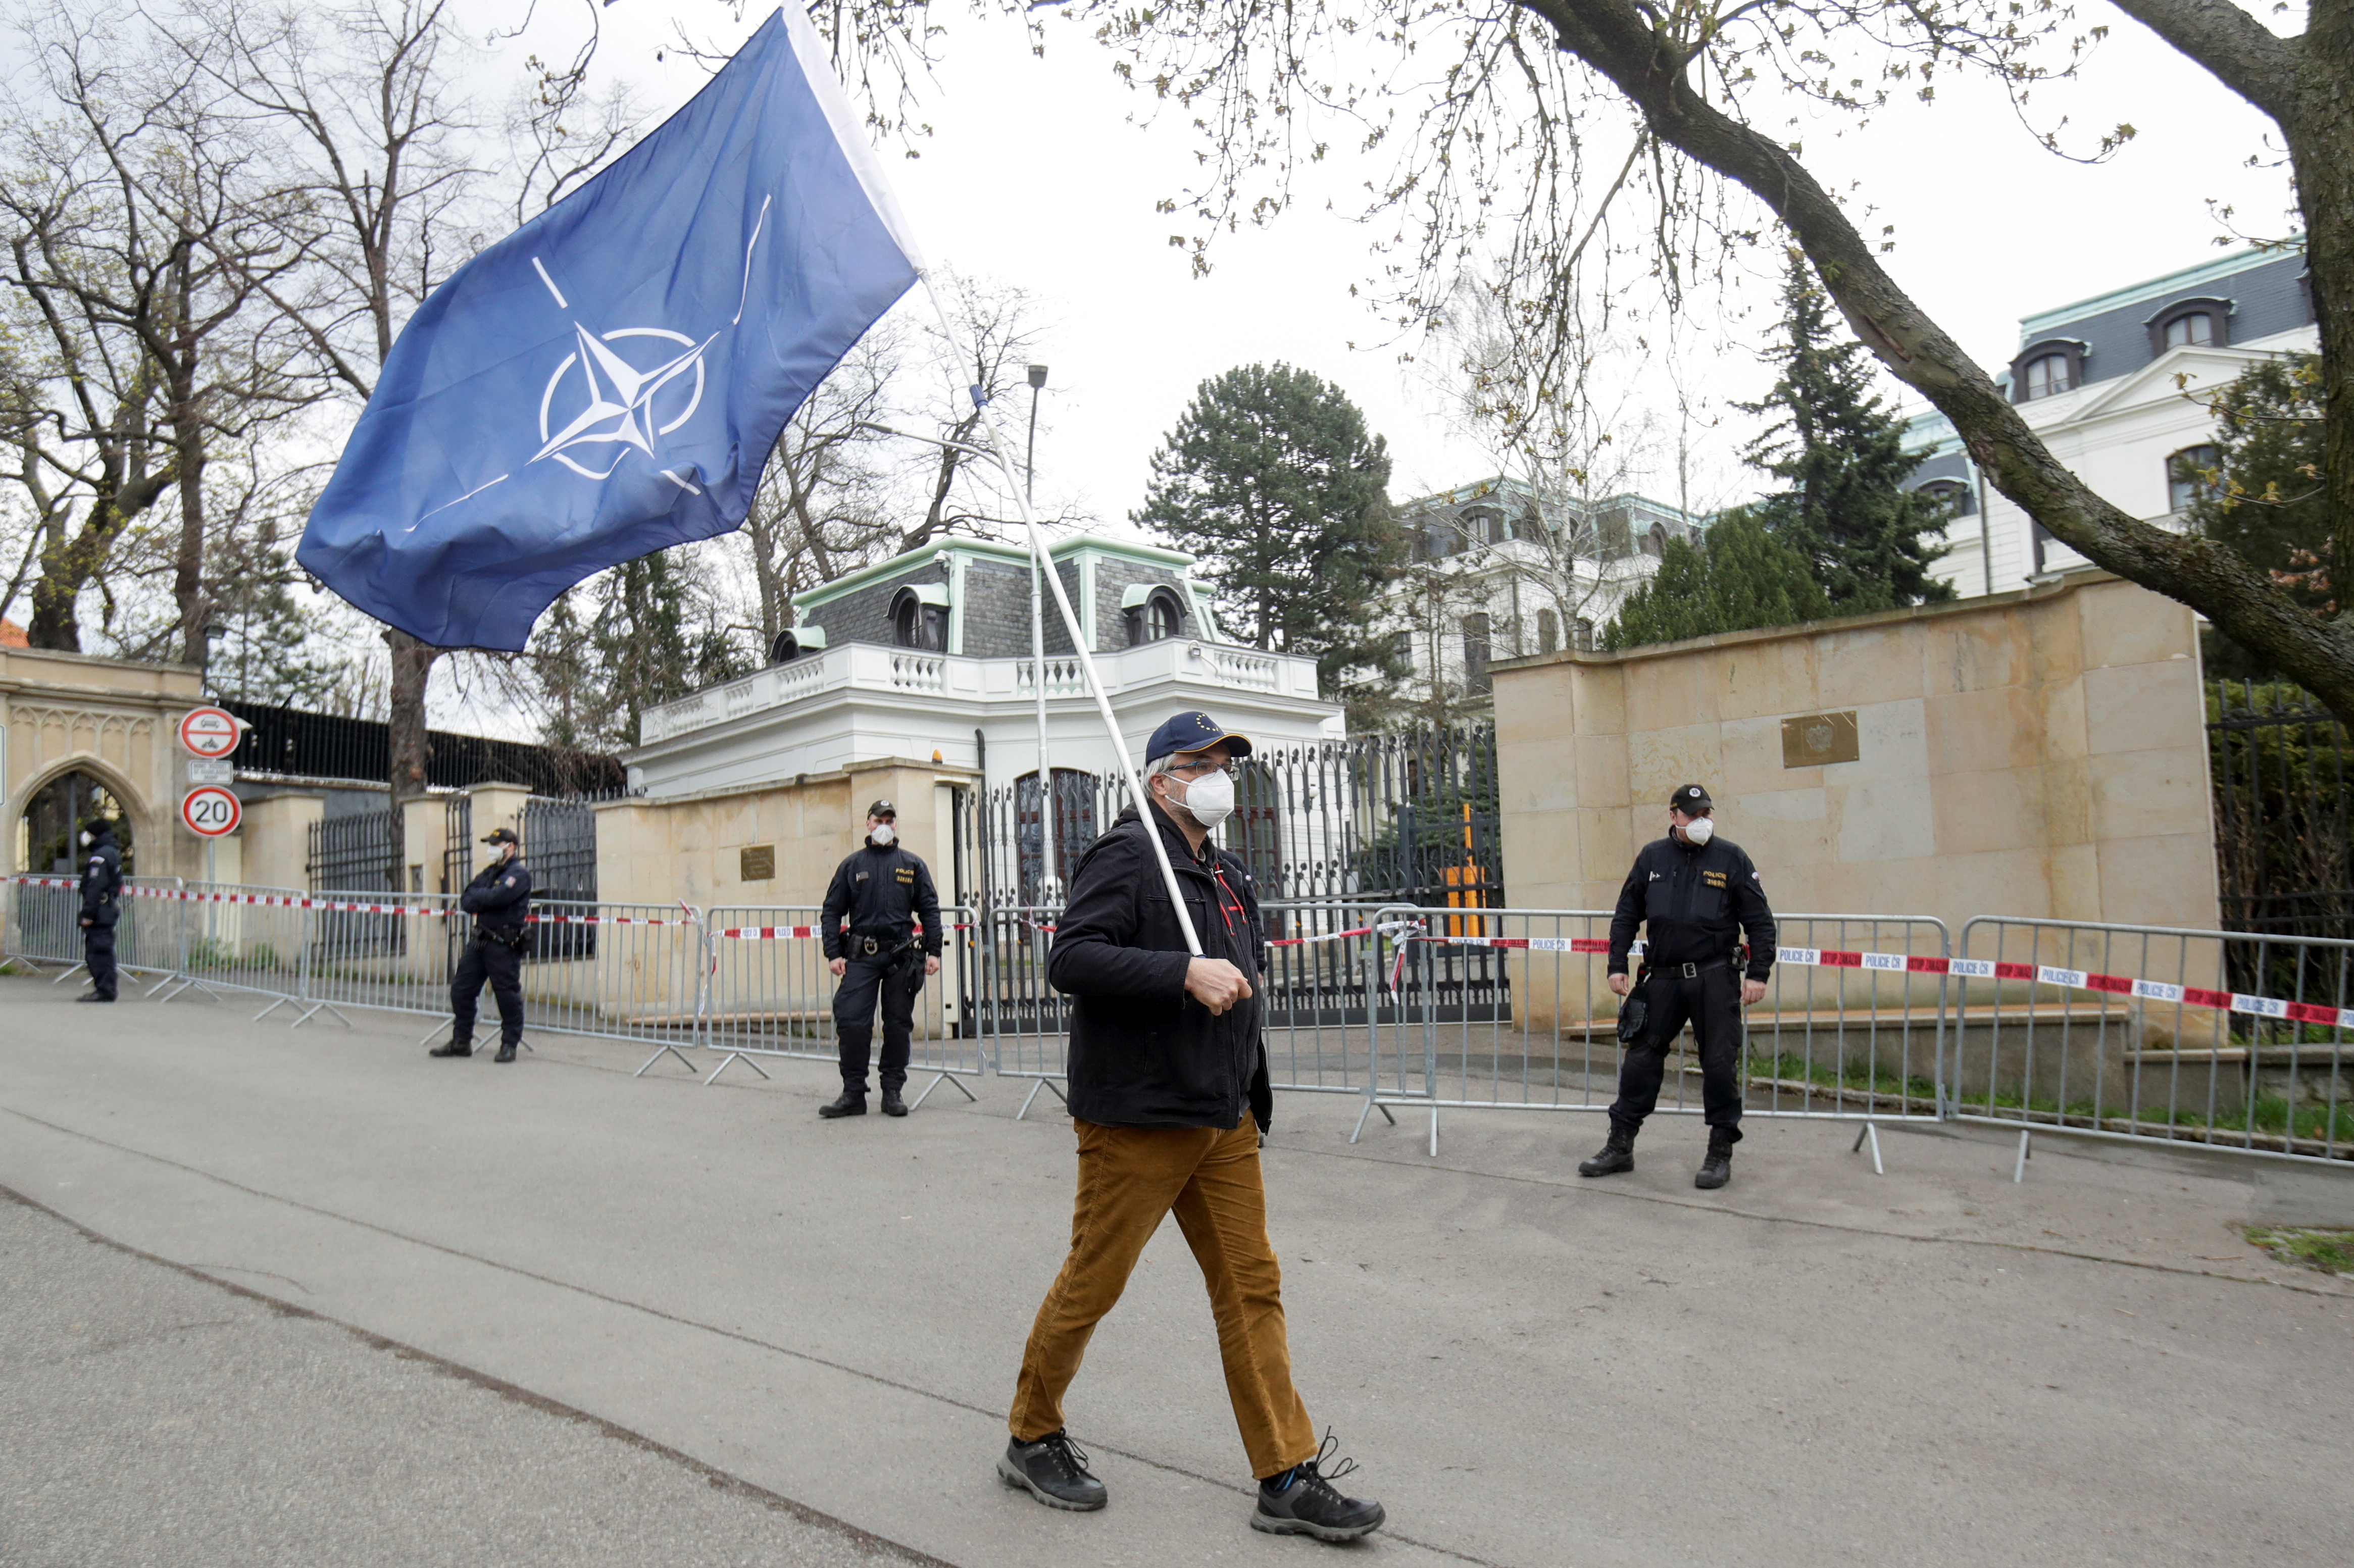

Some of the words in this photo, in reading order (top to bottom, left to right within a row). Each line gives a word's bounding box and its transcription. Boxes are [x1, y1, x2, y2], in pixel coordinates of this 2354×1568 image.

[195, 800, 227, 822] 20
[1533, 939, 1555, 949] POLICIE
[1780, 949, 1804, 962] POLICIE
[1866, 955, 1889, 968] POLICIE
[1953, 961, 1977, 974] POLICIE
[2042, 968, 2069, 983] POLICIE
